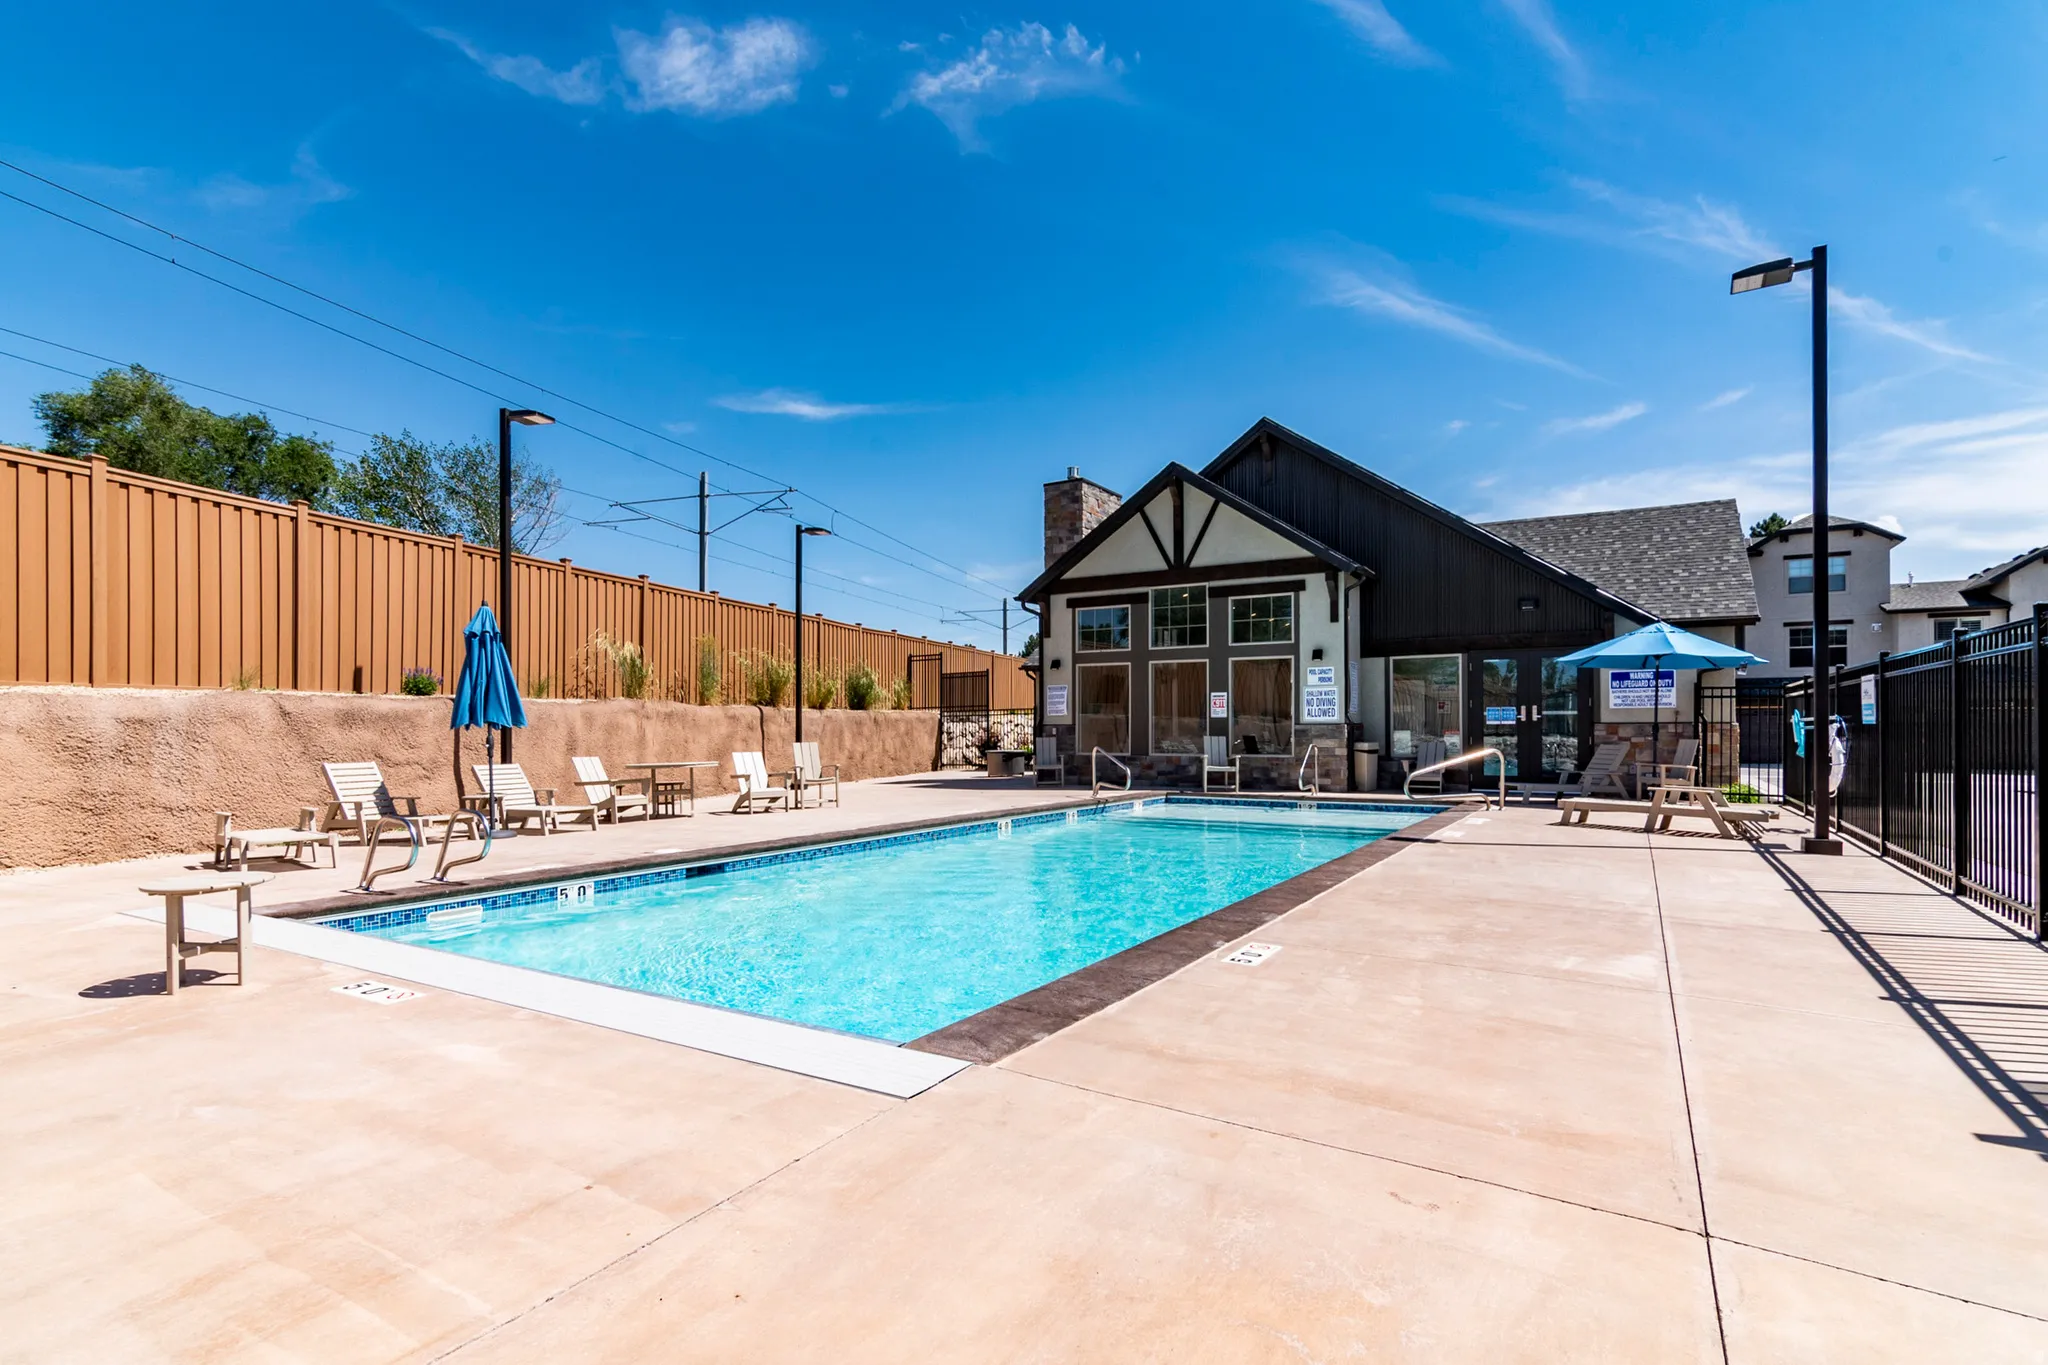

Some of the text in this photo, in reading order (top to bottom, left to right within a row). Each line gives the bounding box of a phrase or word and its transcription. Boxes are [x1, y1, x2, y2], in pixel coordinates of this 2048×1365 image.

[1306, 697, 1336, 707] NO DIVING
[1307, 708, 1335, 717] ALLOWED
[560, 888, 568, 899] 5
